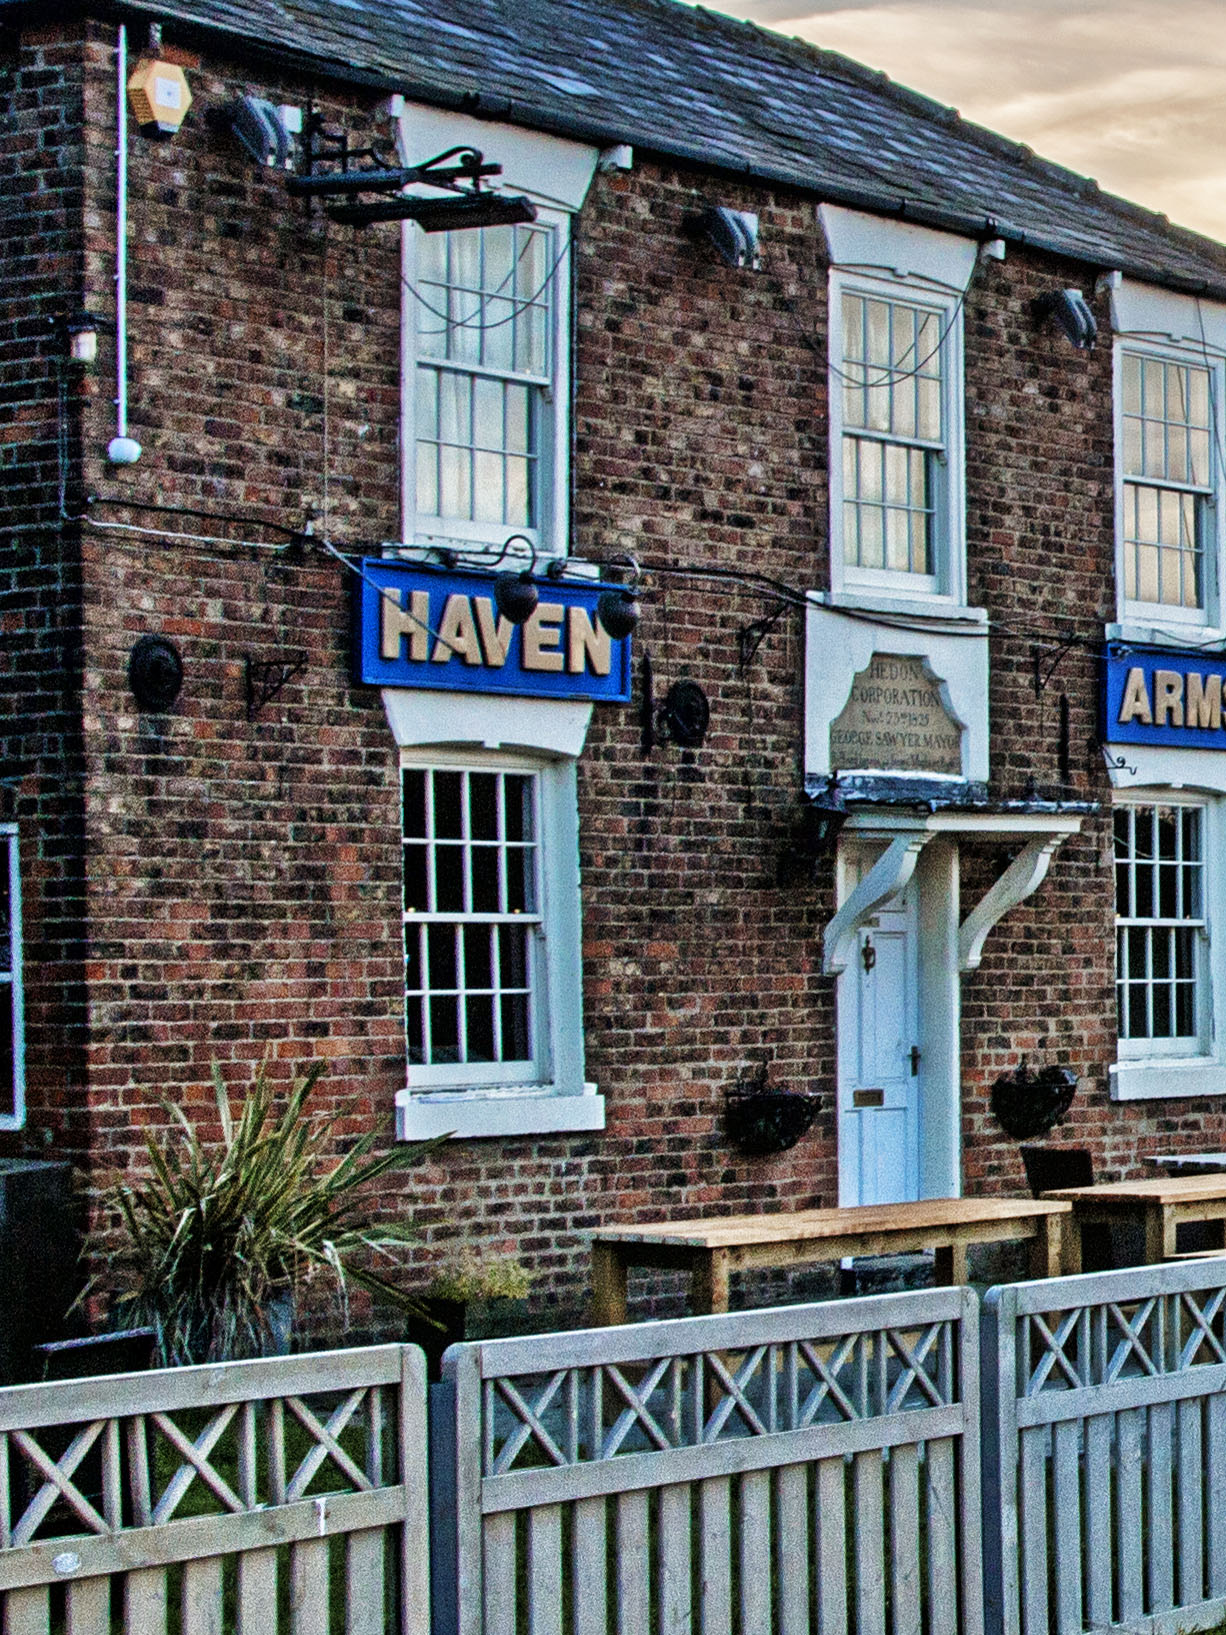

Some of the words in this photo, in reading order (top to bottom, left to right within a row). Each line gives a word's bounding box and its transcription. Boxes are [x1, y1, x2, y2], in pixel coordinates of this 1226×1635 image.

[380, 587, 612, 675] HAVEN
[870, 661, 920, 680] HEDON
[852, 686, 940, 707] CORPORATION
